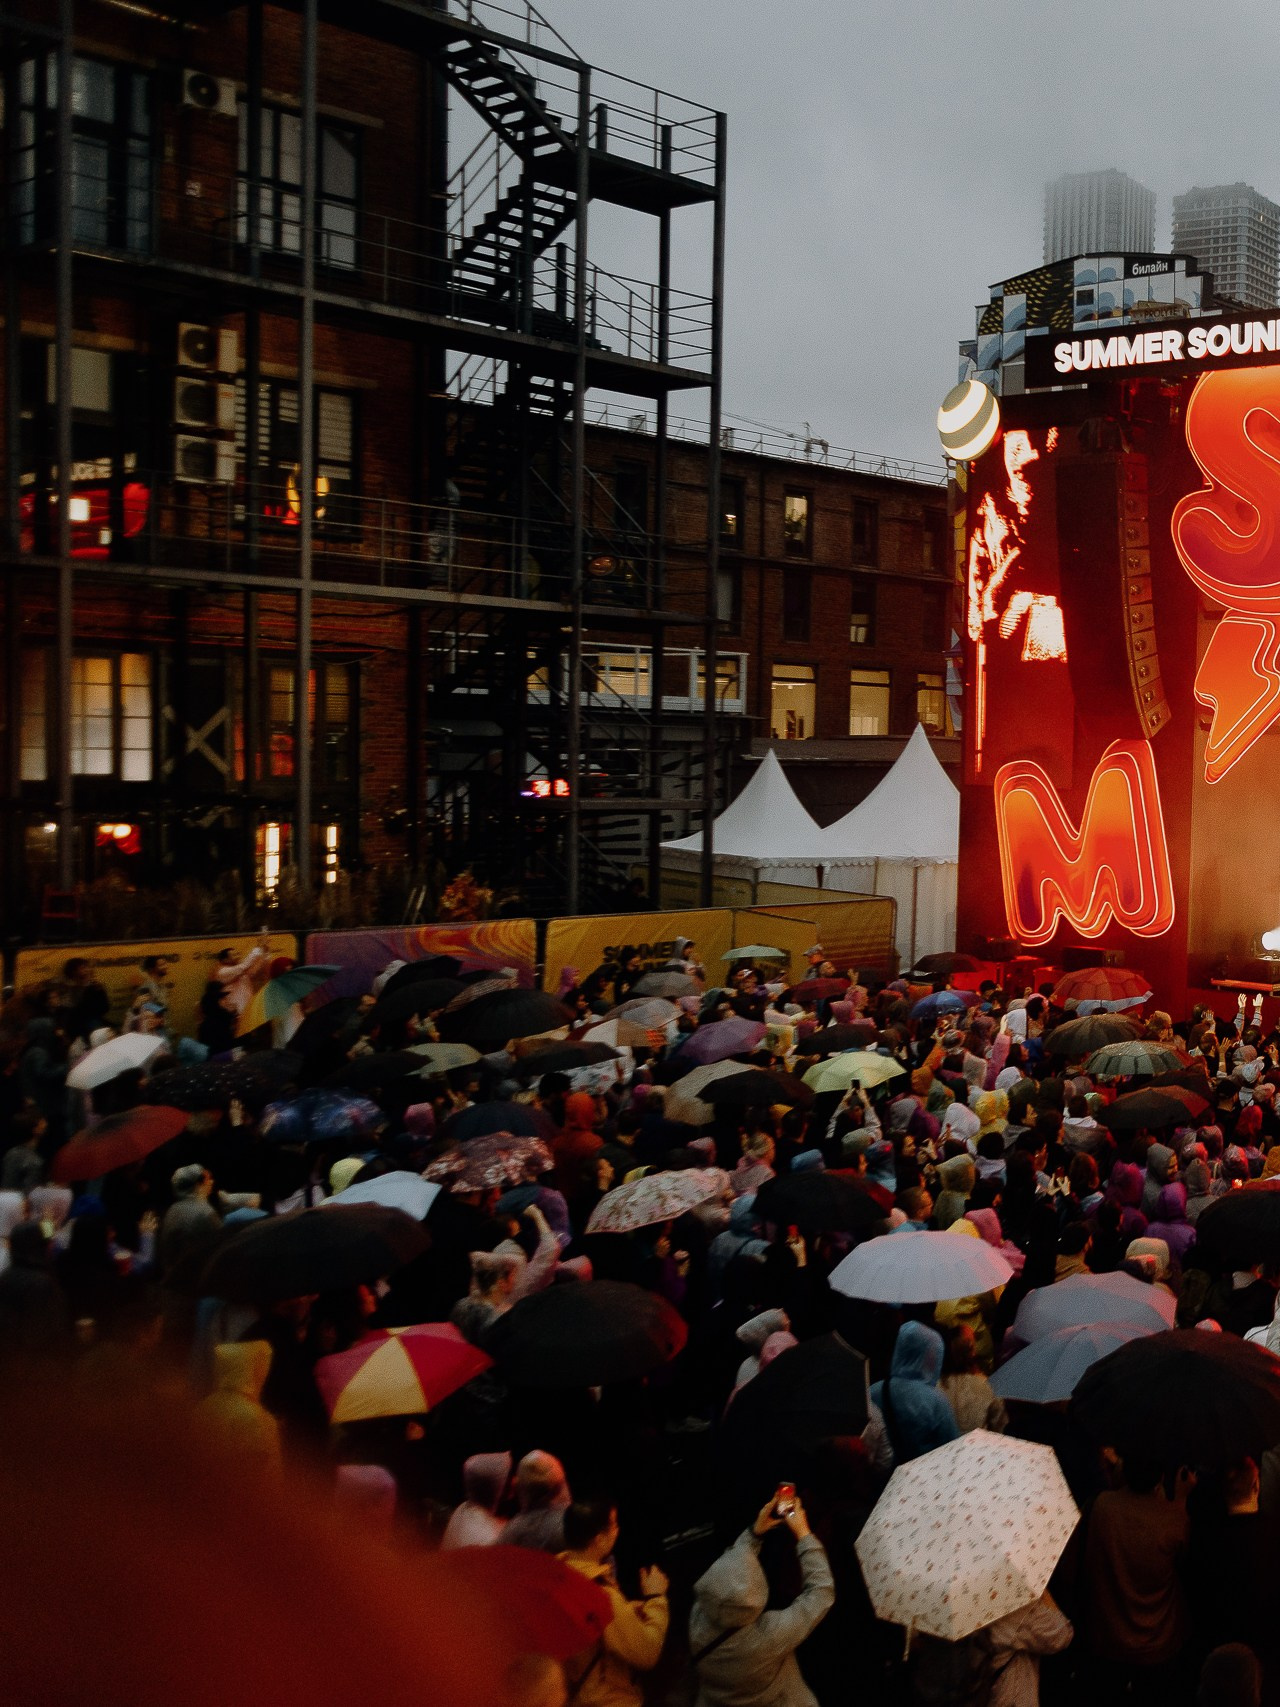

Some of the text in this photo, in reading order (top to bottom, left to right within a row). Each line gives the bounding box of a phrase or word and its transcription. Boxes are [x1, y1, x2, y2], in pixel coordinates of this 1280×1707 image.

[1132, 261, 1168, 275] билайн
[1054, 330, 1185, 373] SUMMER
[994, 739, 1175, 947] M
